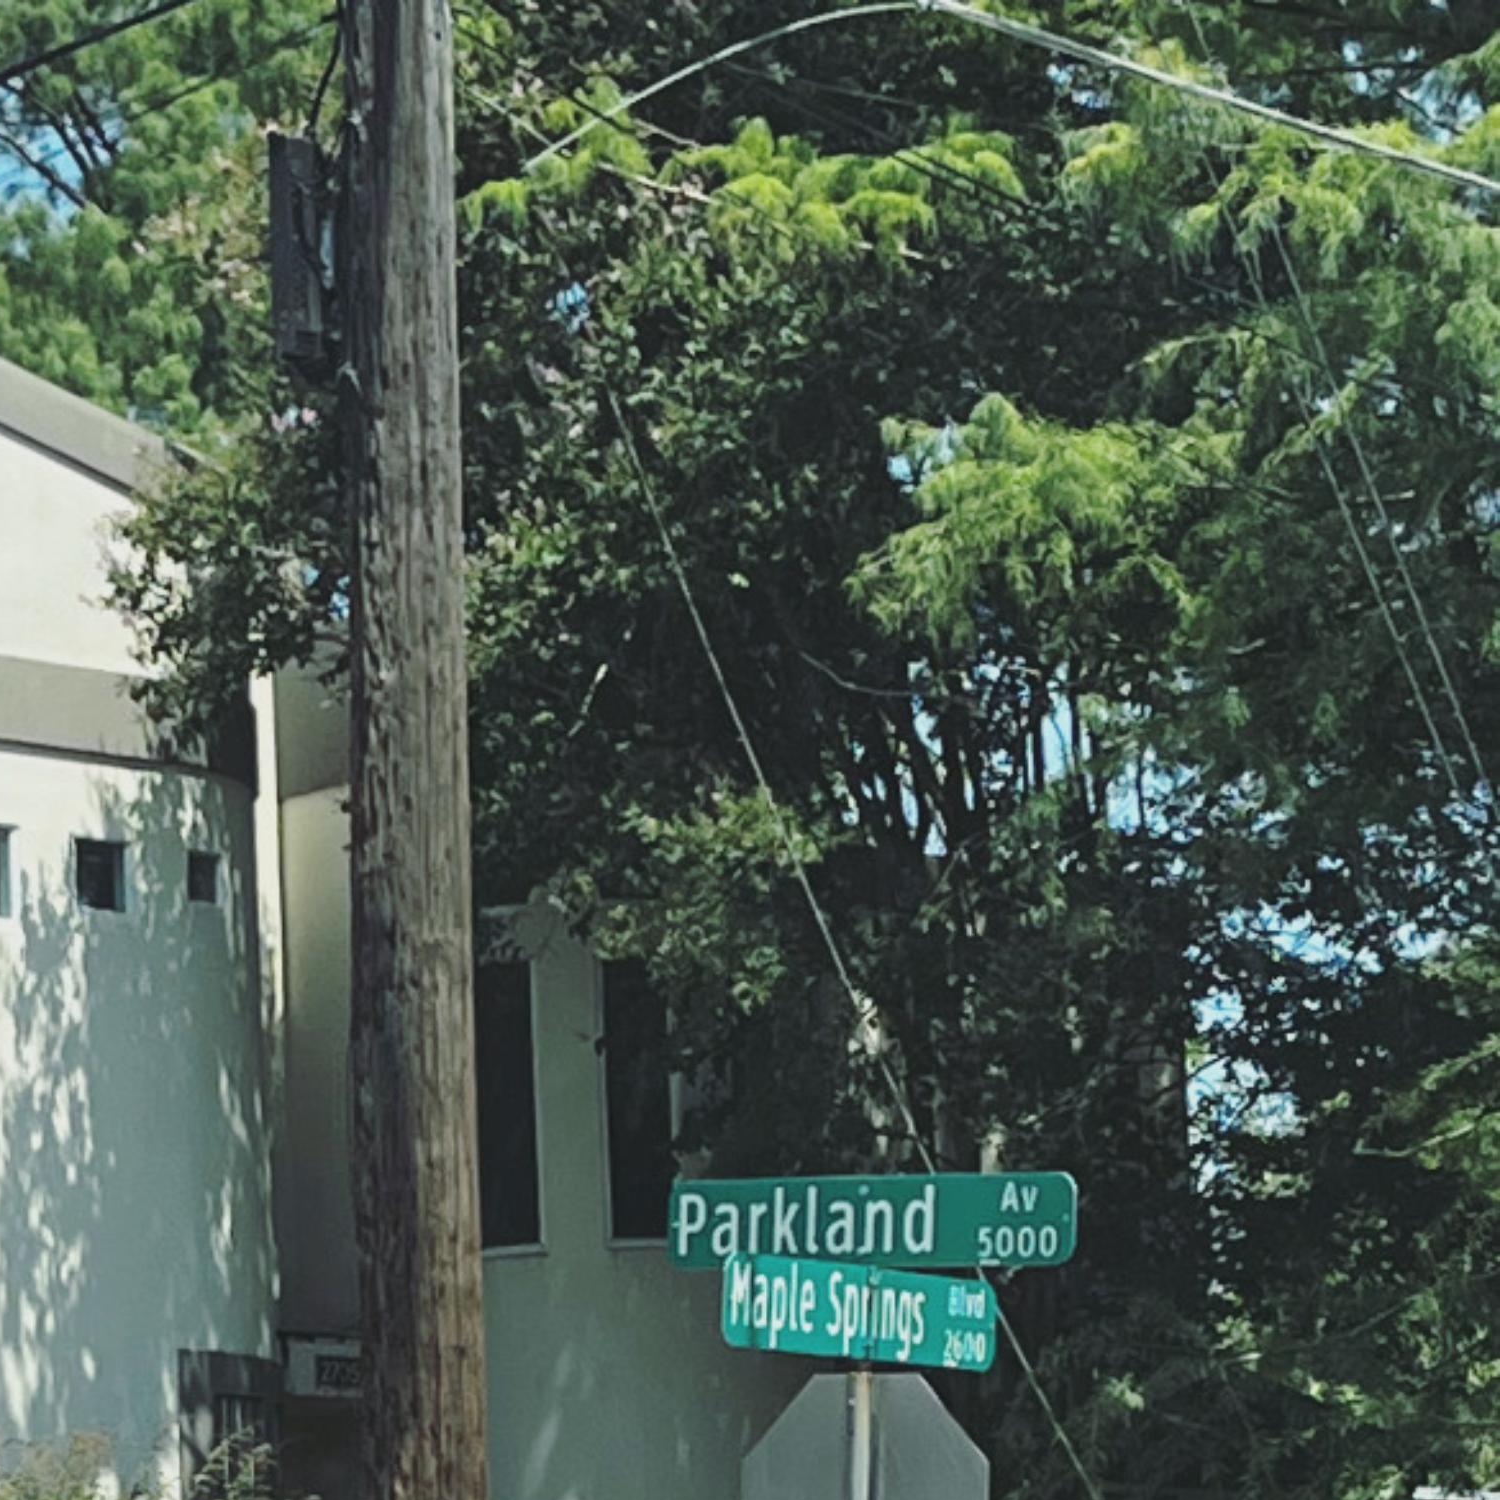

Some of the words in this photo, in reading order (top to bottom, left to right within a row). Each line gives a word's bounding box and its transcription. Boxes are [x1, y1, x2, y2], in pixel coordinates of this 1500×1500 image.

[1000, 1181, 1037, 1212] Av
[678, 1184, 934, 1256] Parkland
[978, 1226, 1057, 1258] 5000
[731, 1261, 816, 1348] Maple
[827, 1271, 926, 1359] Springs
[948, 1284, 985, 1319] Blvd
[943, 1328, 986, 1362] 2600
